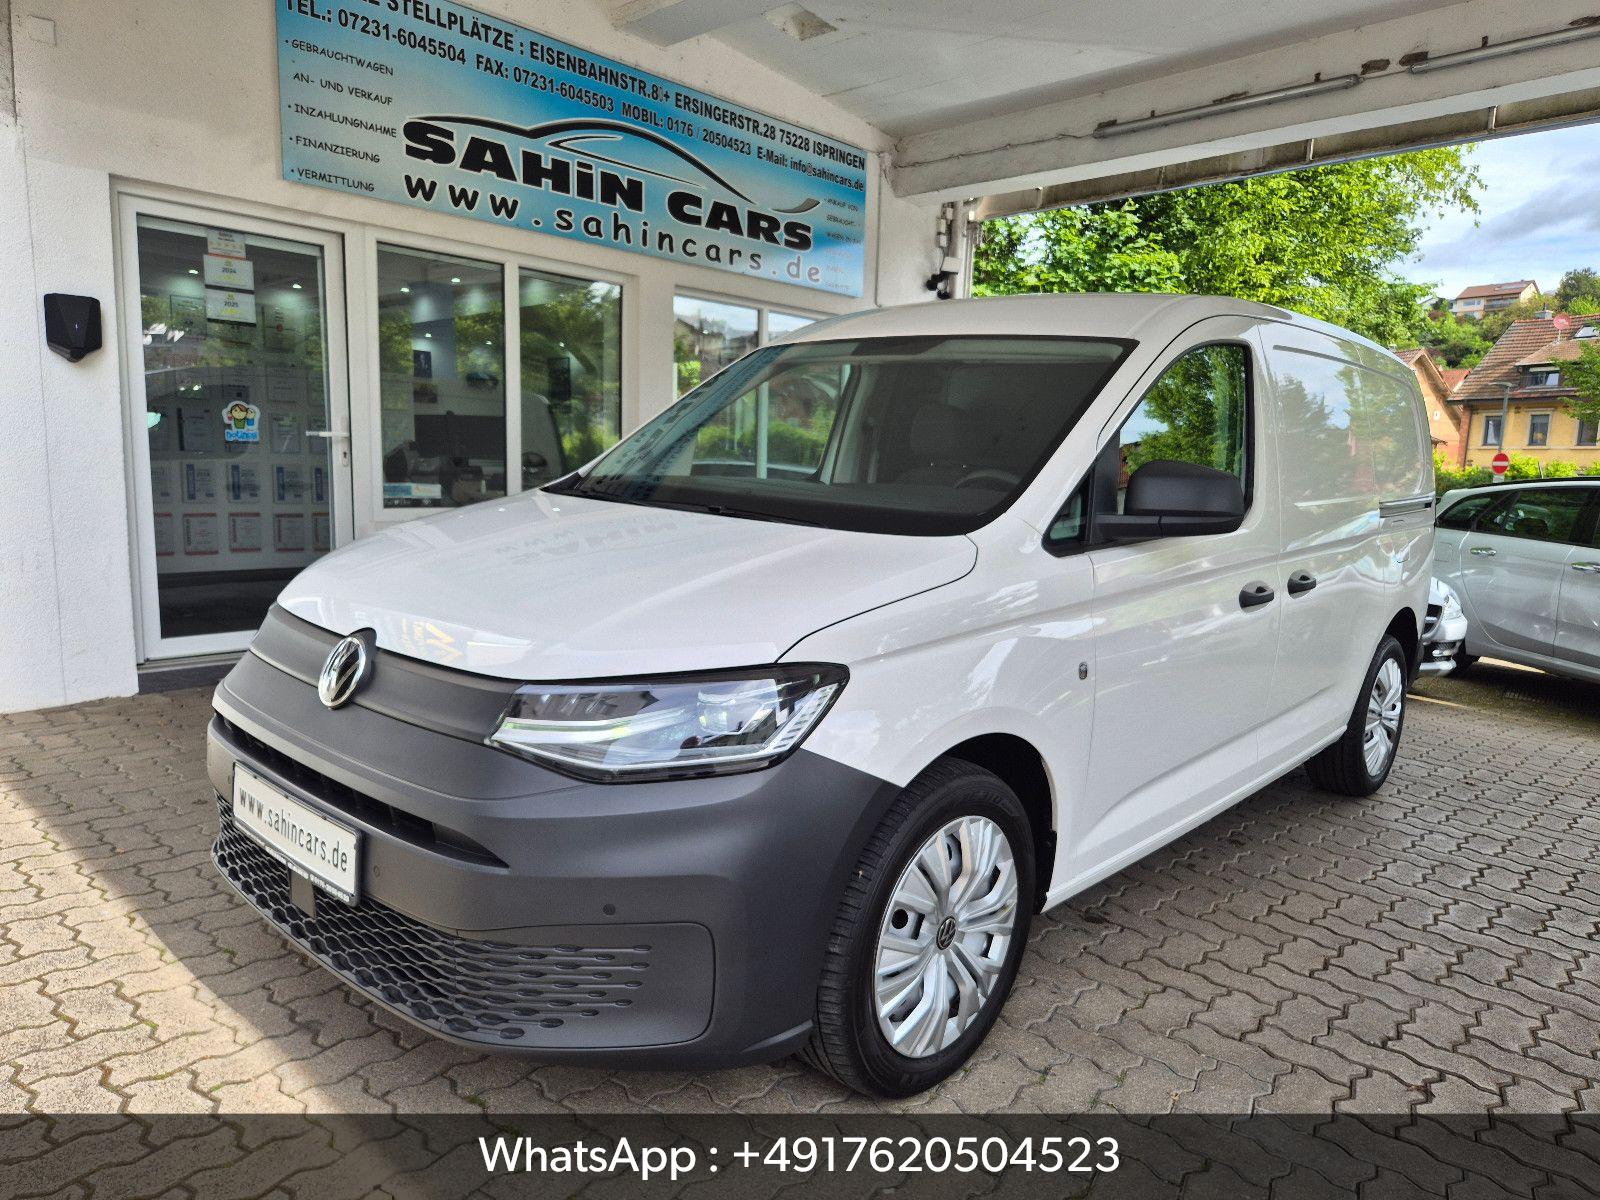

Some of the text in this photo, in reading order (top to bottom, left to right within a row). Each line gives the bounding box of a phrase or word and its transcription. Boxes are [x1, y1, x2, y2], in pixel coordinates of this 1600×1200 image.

[291, 38, 394, 76] GEBRAUCHTWAGEN
[293, 72, 394, 106] AN- UND VERKAUF
[338, 9, 465, 65] 07231-6045504
[476, 53, 509, 79] FAX:
[513, 66, 614, 112] 07231-6045503
[621, 102, 664, 127] MOBIL:
[667, 117, 693, 138] 0176
[702, 128, 752, 156] 20504523
[757, 146, 788, 167] E-Mail:
[790, 157, 865, 191] info@sahincars.de
[387, 0, 514, 52] STELLPLÄTZE
[675, 91, 776, 141] ERSINGERSTR.28
[779, 128, 810, 152] 75228
[812, 140, 866, 171] ISPRINGEN
[294, 103, 397, 138] INZAHLUNGNAHME
[295, 136, 381, 163] FINANZIERUNG
[298, 168, 375, 192] VERMITTLUNG
[667, 191, 812, 251] CARS
[239, 787, 348, 873] www.sahincars.de
